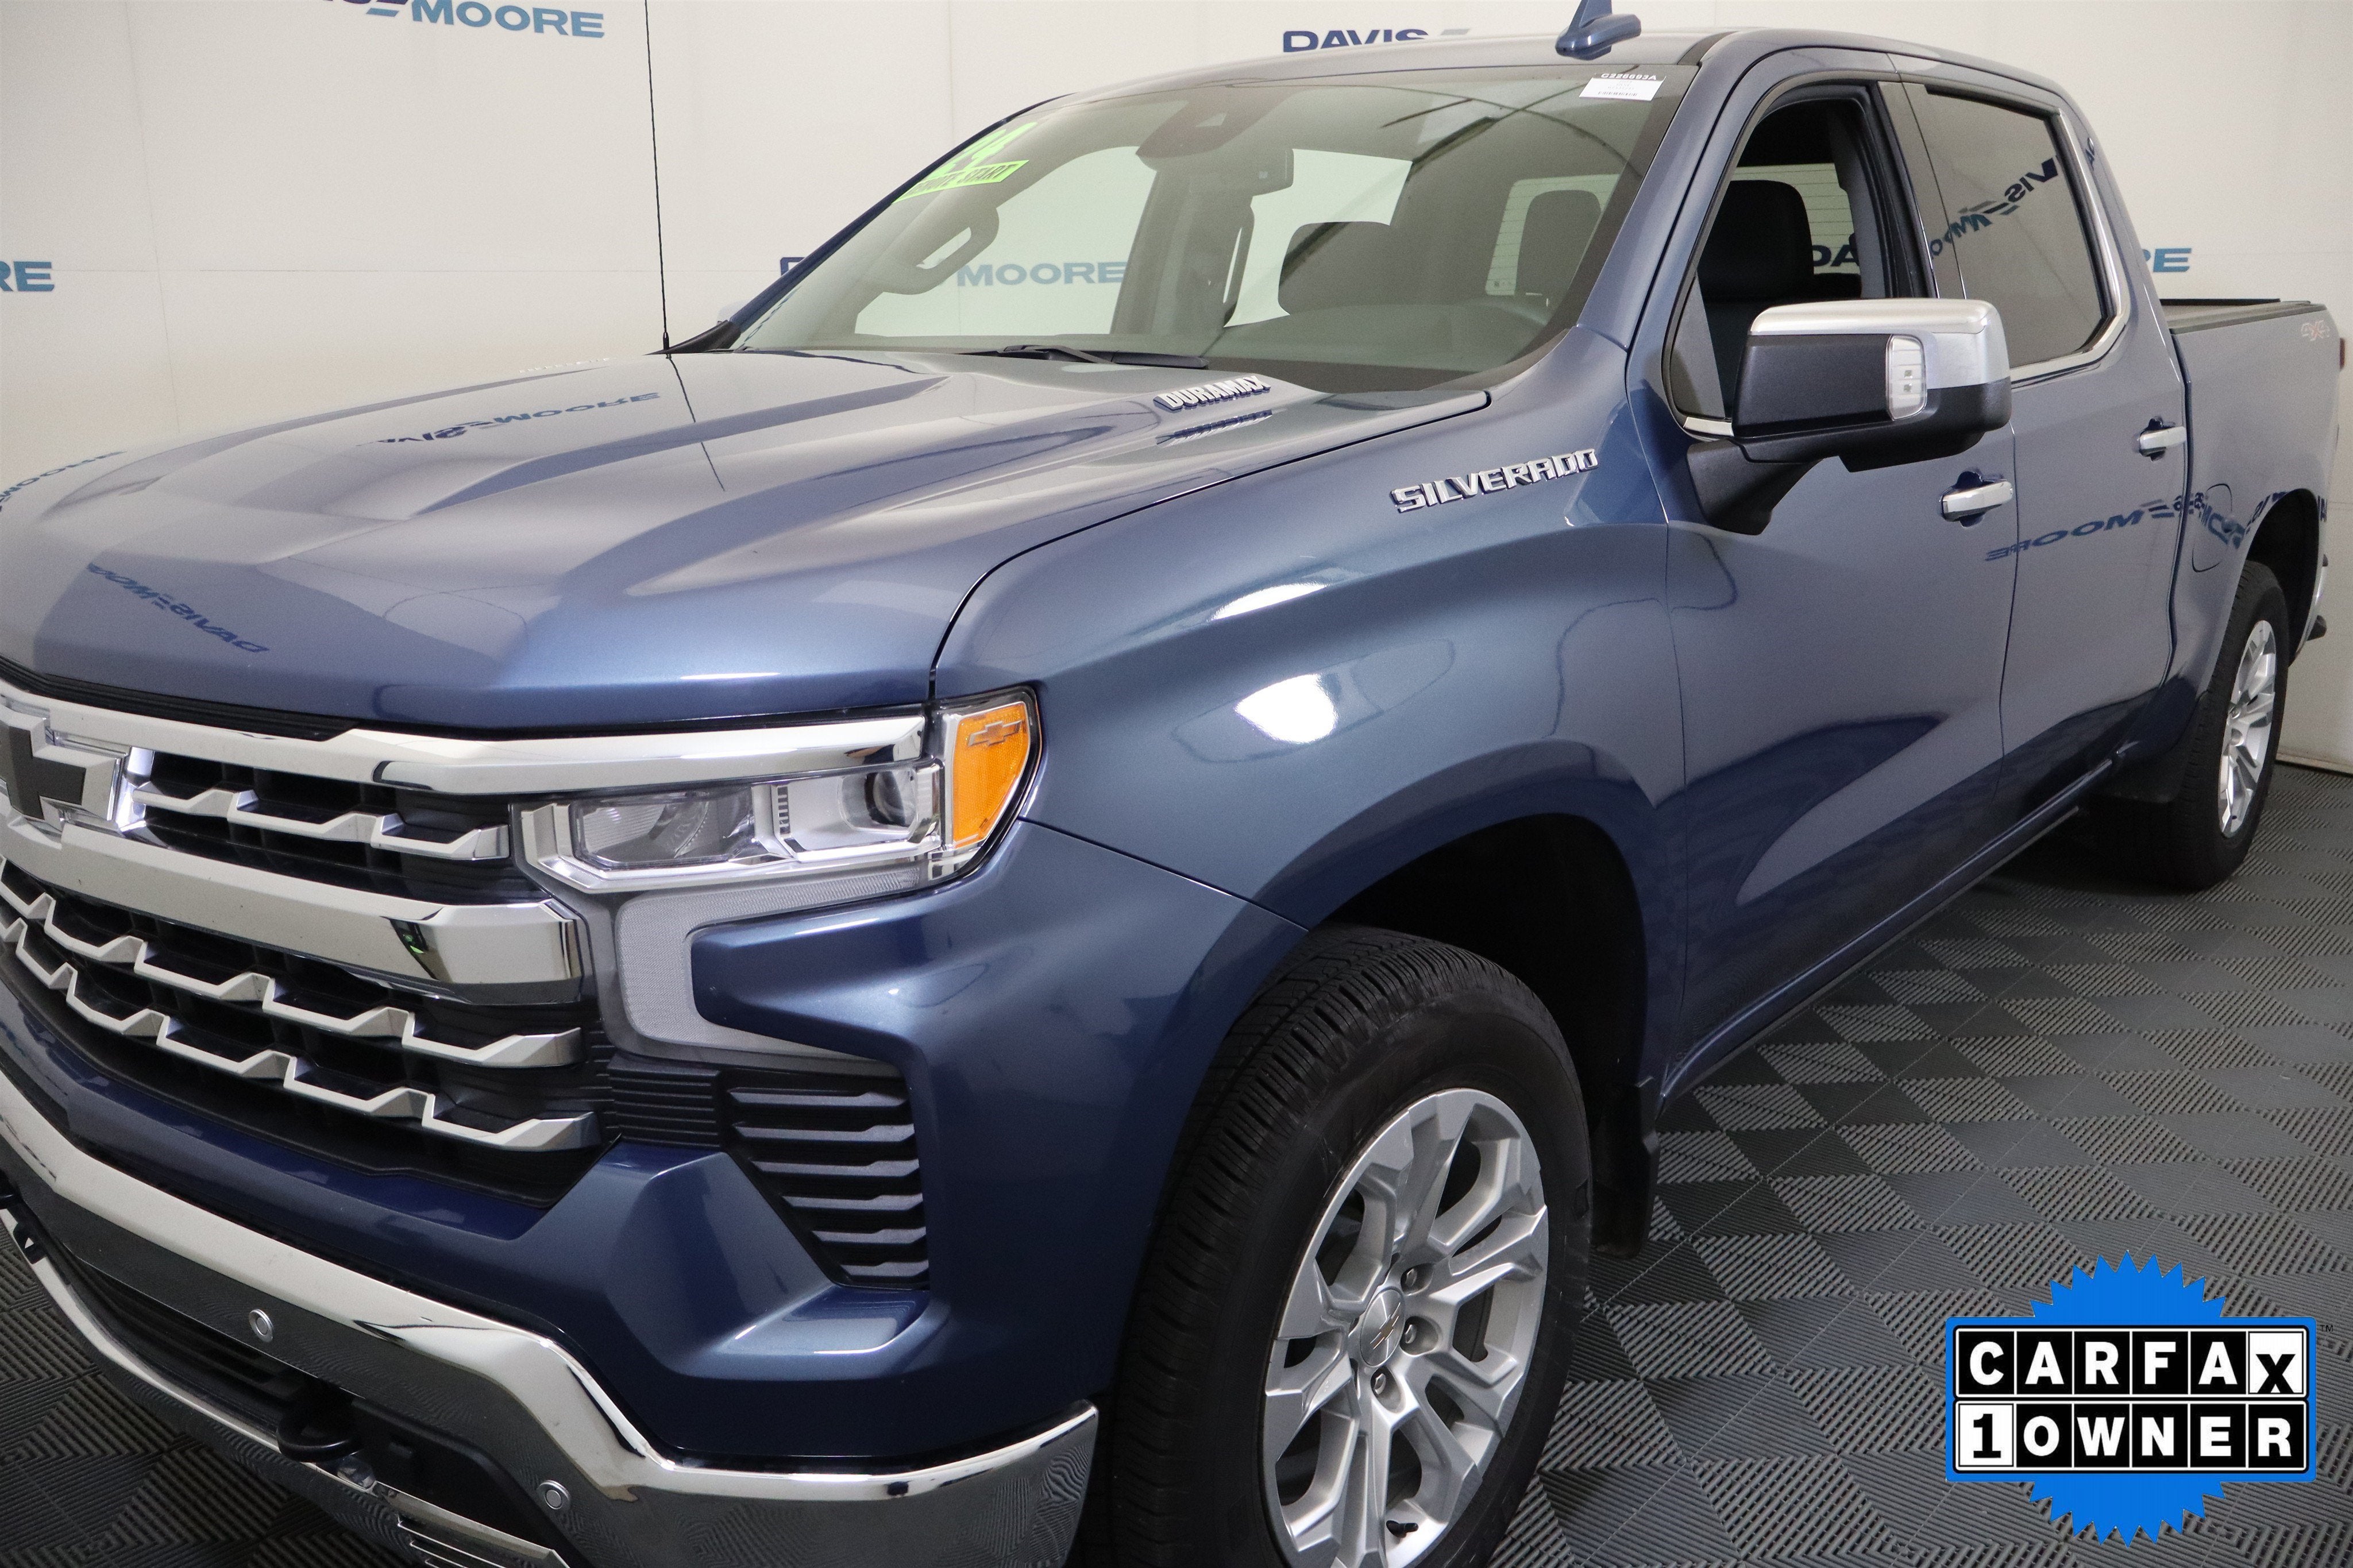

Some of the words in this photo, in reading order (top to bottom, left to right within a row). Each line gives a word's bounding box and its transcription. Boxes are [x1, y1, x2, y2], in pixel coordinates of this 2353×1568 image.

[412, 0, 605, 38] MOORE
[957, 261, 1128, 287] MOORE
[1154, 376, 1271, 410] DURAMAX
[1390, 449, 1599, 513] SILVERADO
